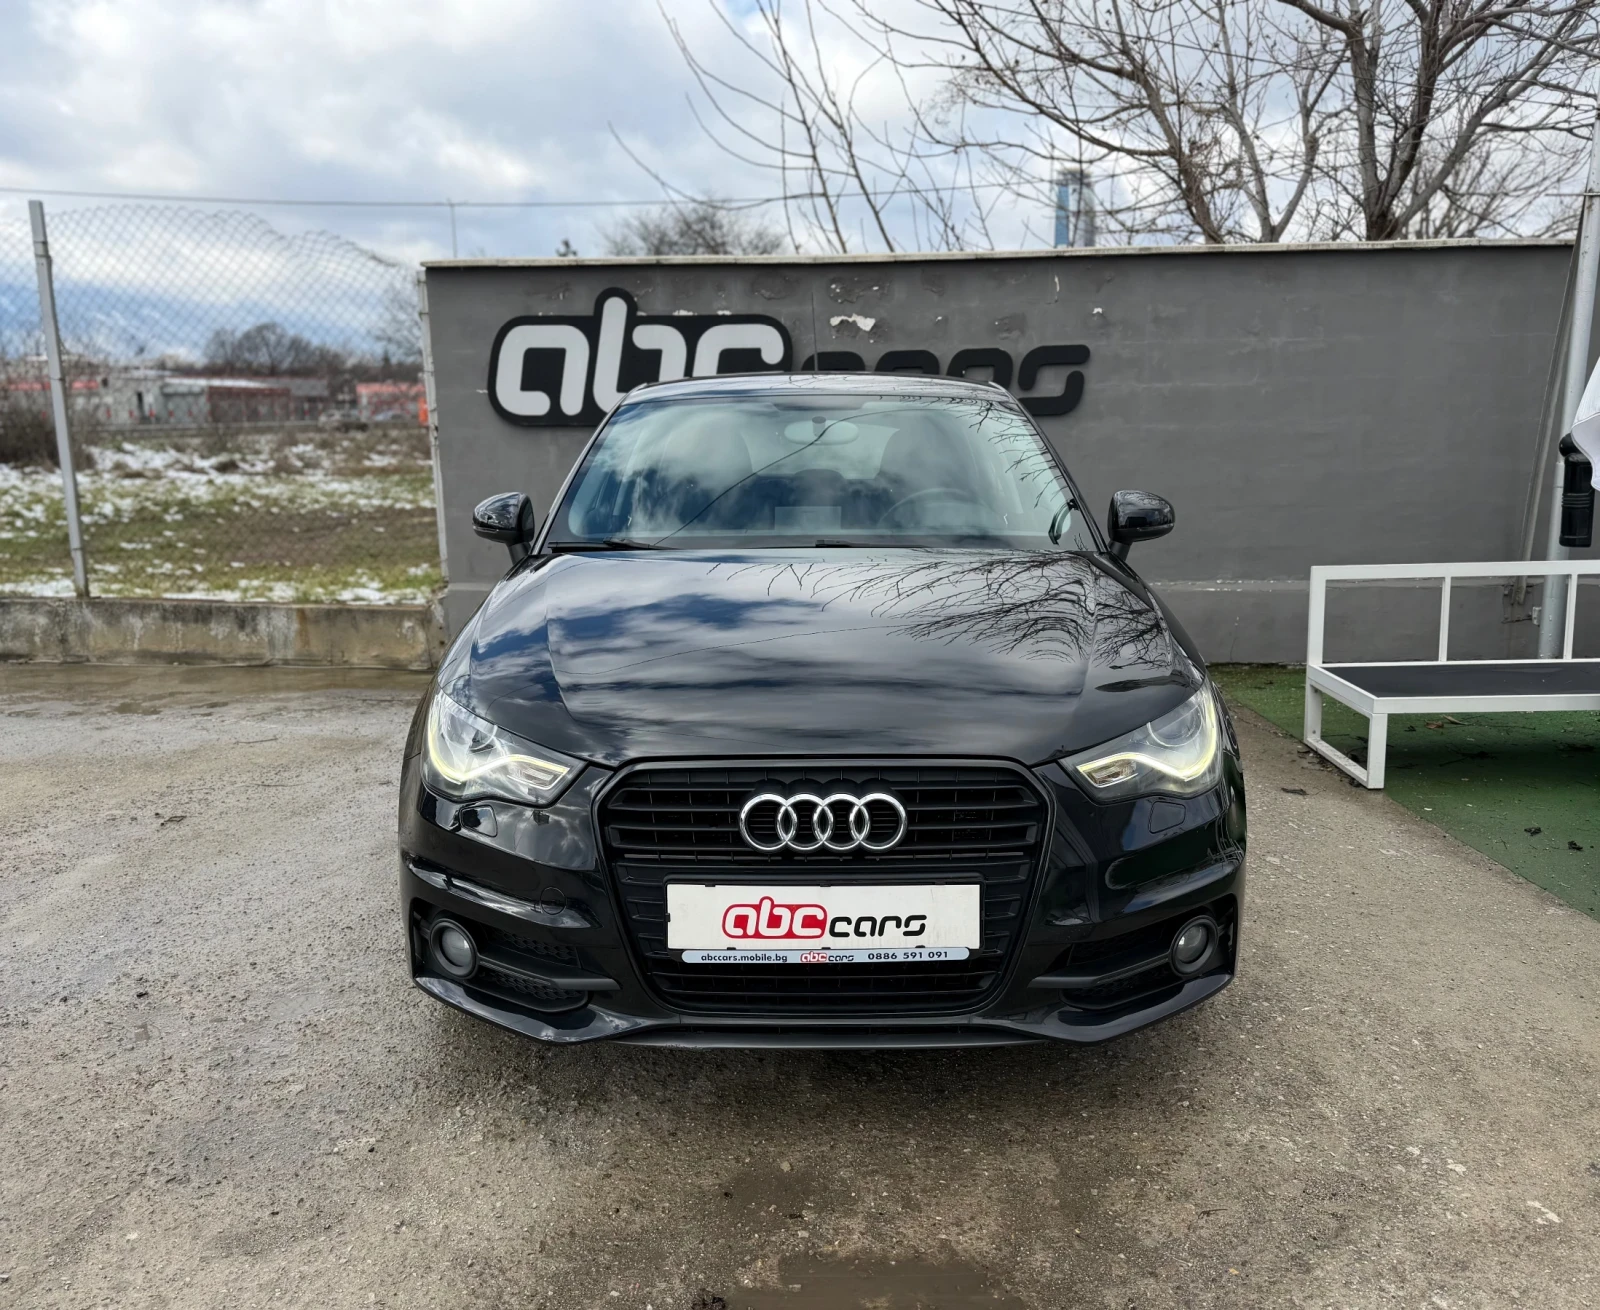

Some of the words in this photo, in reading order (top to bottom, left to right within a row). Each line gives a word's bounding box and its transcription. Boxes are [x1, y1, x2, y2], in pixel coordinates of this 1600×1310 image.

[724, 897, 826, 938] abc
[828, 914, 928, 938] cars
[700, 953, 788, 963] abccars.mobile.bg
[828, 954, 854, 963] cars
[867, 952, 898, 960] 0886
[902, 951, 923, 960] 591
[927, 950, 948, 959] 091
